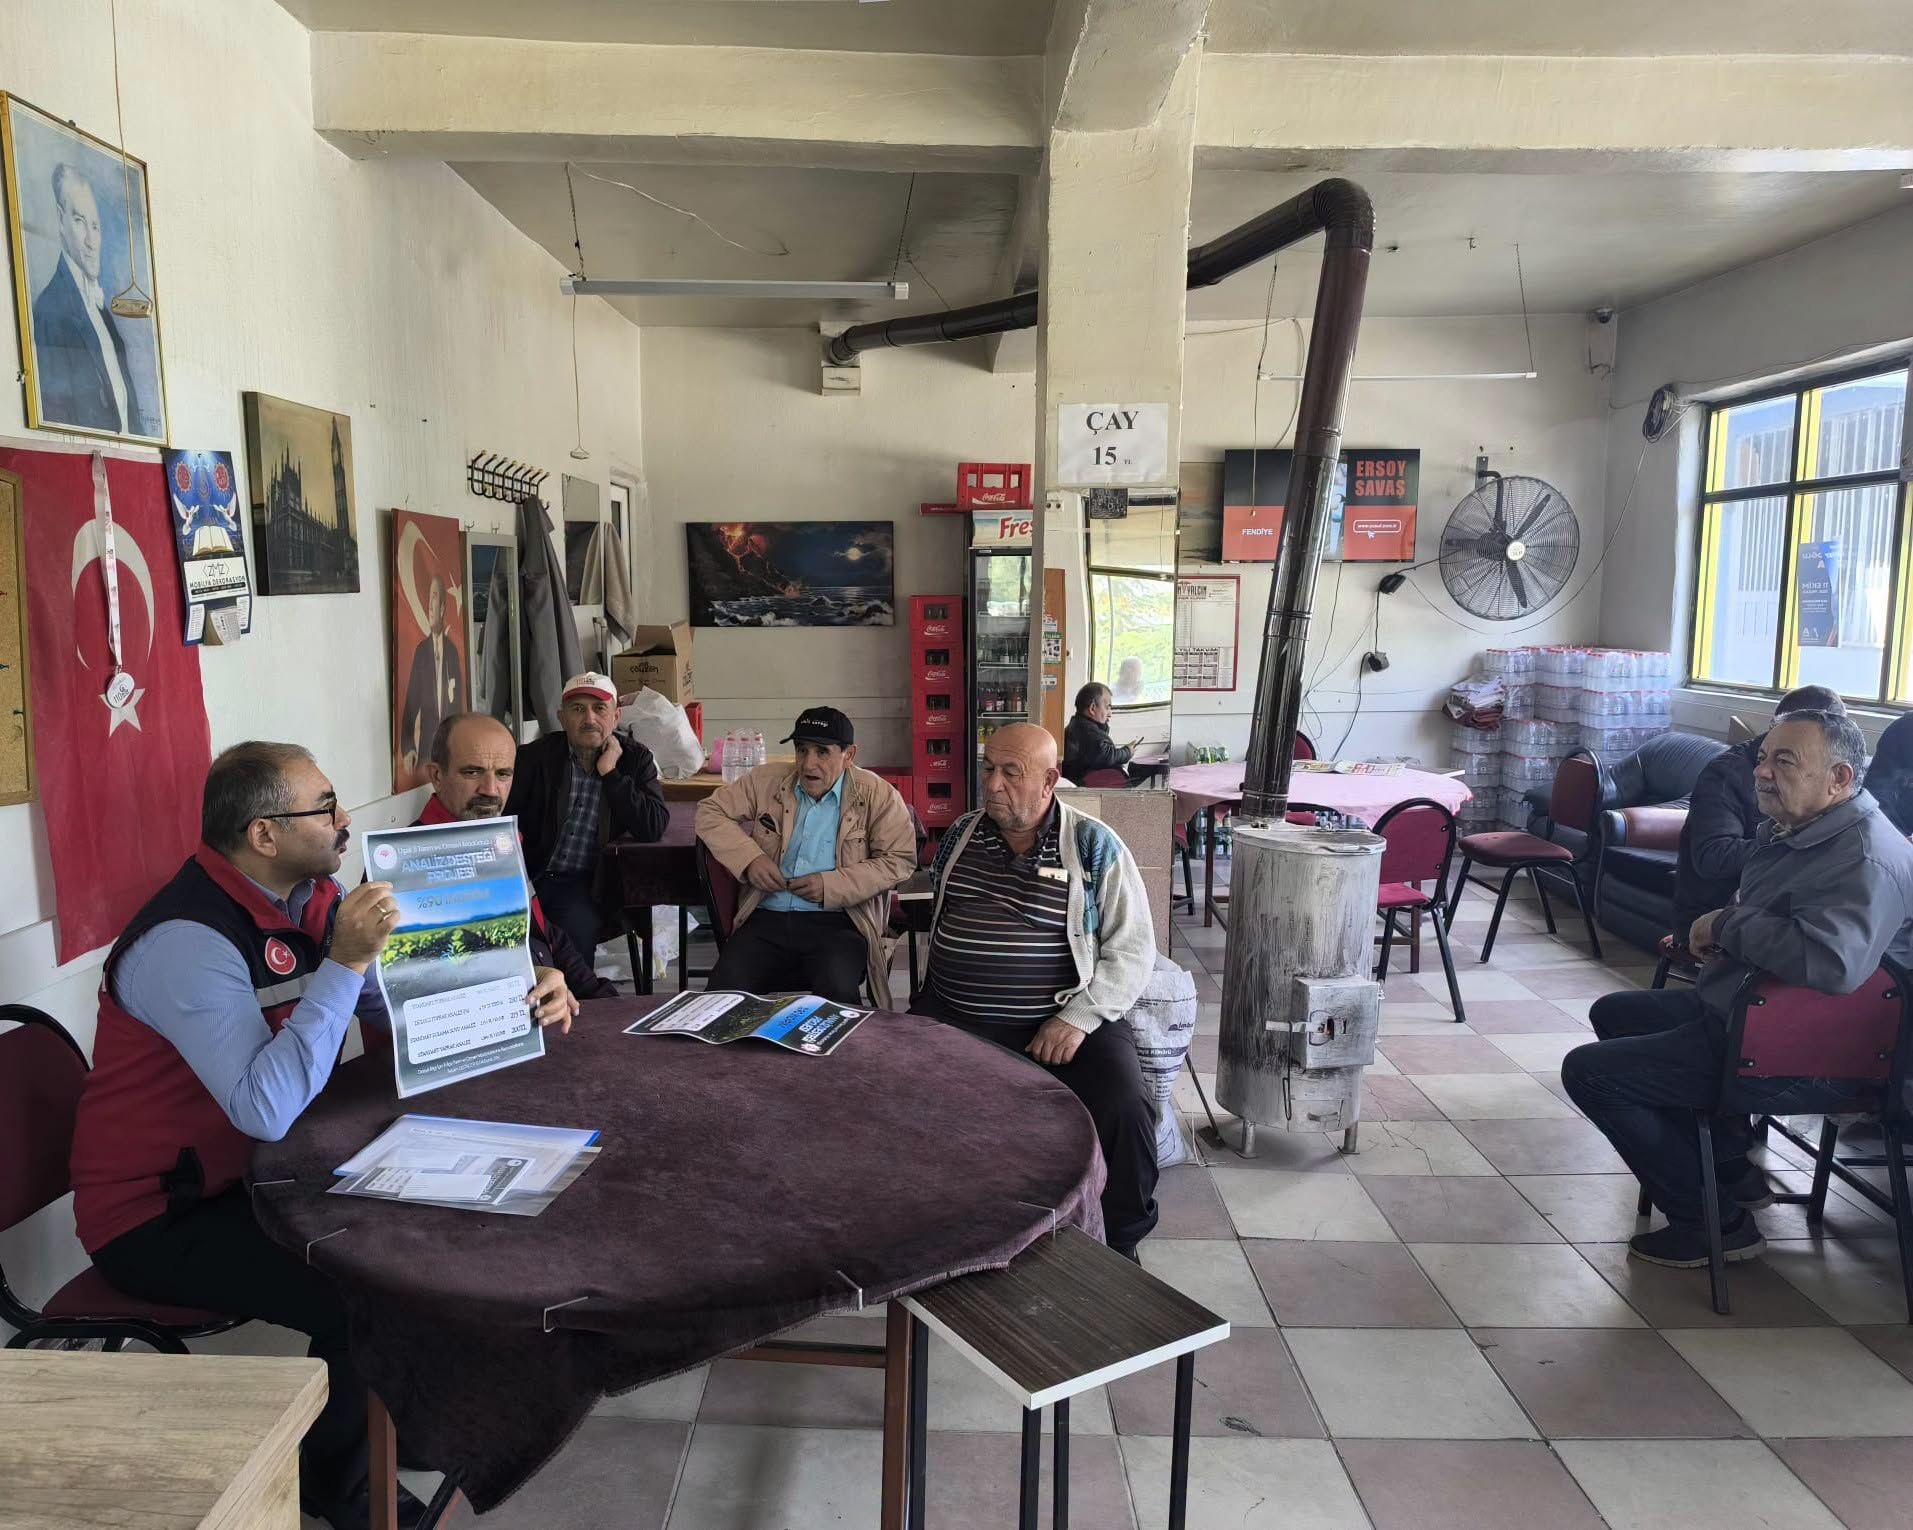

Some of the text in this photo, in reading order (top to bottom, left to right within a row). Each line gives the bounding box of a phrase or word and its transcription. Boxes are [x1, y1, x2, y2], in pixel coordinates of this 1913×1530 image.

[1086, 410, 1139, 435] ÇAY
[1092, 446, 1117, 466] 15
[1356, 460, 1407, 477] ERSOY
